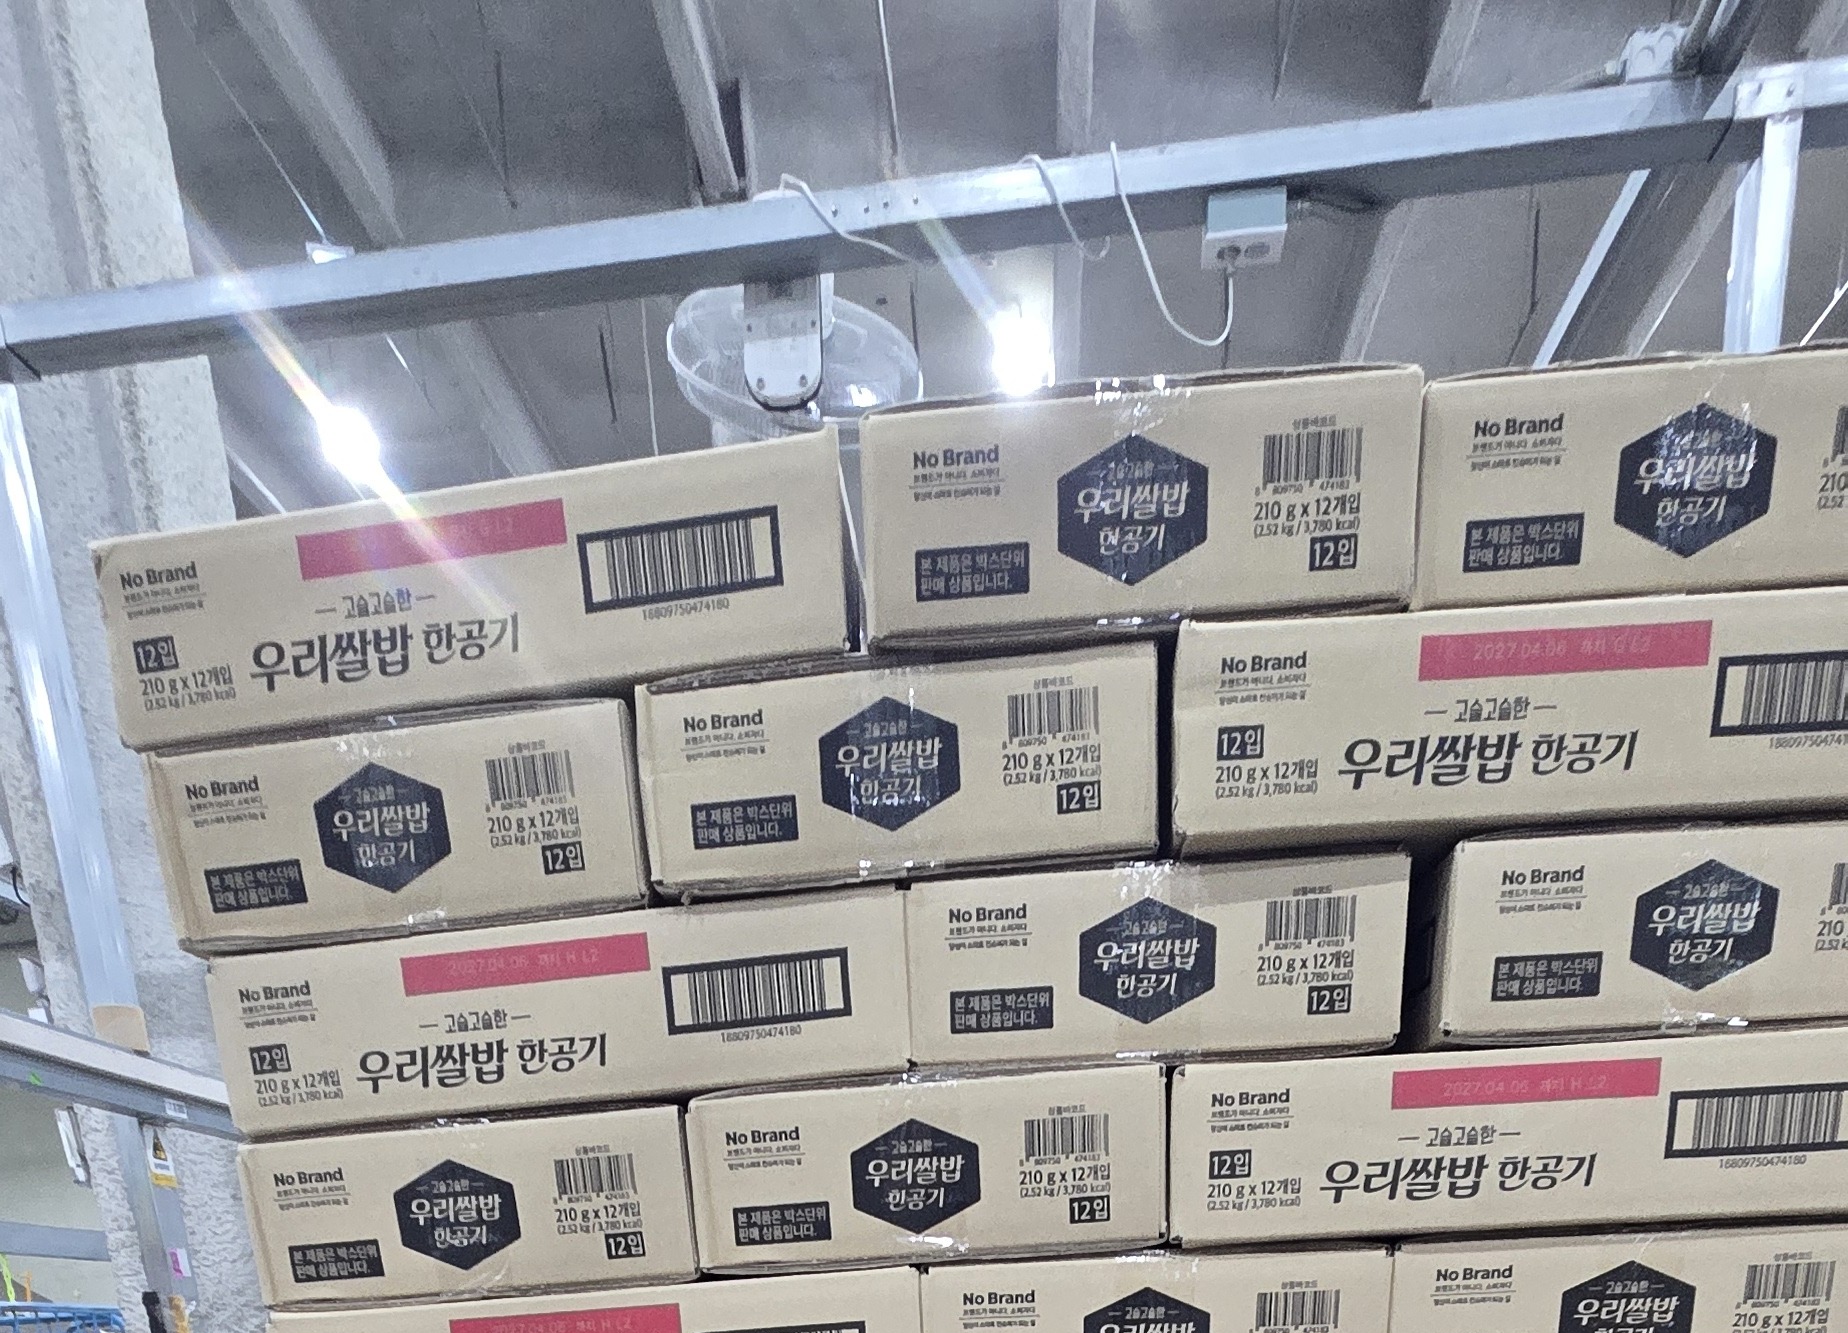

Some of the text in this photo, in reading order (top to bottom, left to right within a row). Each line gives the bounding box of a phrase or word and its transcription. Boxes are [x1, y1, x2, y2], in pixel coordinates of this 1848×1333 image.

[1474, 413, 1564, 438] No Brand
[914, 443, 999, 469] No Brand
[1073, 480, 1191, 524] 우리쌀밥
[1254, 501, 1281, 521] 210
[1286, 504, 1296, 522] g
[1315, 491, 1361, 517] 12개입
[1099, 523, 1166, 555] 한공기
[1314, 537, 1357, 567] 12입
[119, 561, 198, 589] No Brand
[936, 554, 973, 574] 제품은
[975, 549, 1025, 570] 박스단위
[137, 640, 176, 668] 12입
[251, 613, 519, 692] 우리쌀밥 한공기
[1221, 651, 1307, 674] No Brand
[139, 677, 165, 696] 210
[168, 678, 179, 695] g
[191, 664, 233, 688] 12개입
[1221, 728, 1262, 755] 12입
[1216, 765, 1242, 783] 210
[1246, 768, 1256, 784] g
[1274, 758, 1319, 780] 12개입
[1338, 730, 1639, 789] 우리쌀밥 한공기
[332, 801, 432, 842] 우리쌀밥
[358, 838, 415, 868] 한공기
[950, 903, 1027, 924] No Brand
[1648, 900, 1761, 936] 우리쌀밥
[1669, 937, 1734, 964] 한공기
[1312, 987, 1351, 1012] 12입
[357, 1032, 606, 1094] 우리쌀밥 한공기
[1212, 1088, 1291, 1107] No Brand
[865, 1154, 965, 1187] 우리쌀밥
[1213, 1152, 1249, 1175] 12입
[1207, 1183, 1232, 1198] 210
[1235, 1185, 1245, 1199] g
[1261, 1177, 1302, 1195] 12개입
[1319, 1153, 1597, 1203] 우리쌀밥 한공기
[888, 1187, 945, 1211] 한공기
[1072, 1197, 1110, 1221] 12입
[1574, 1296, 1679, 1326] 우리쌀밥
